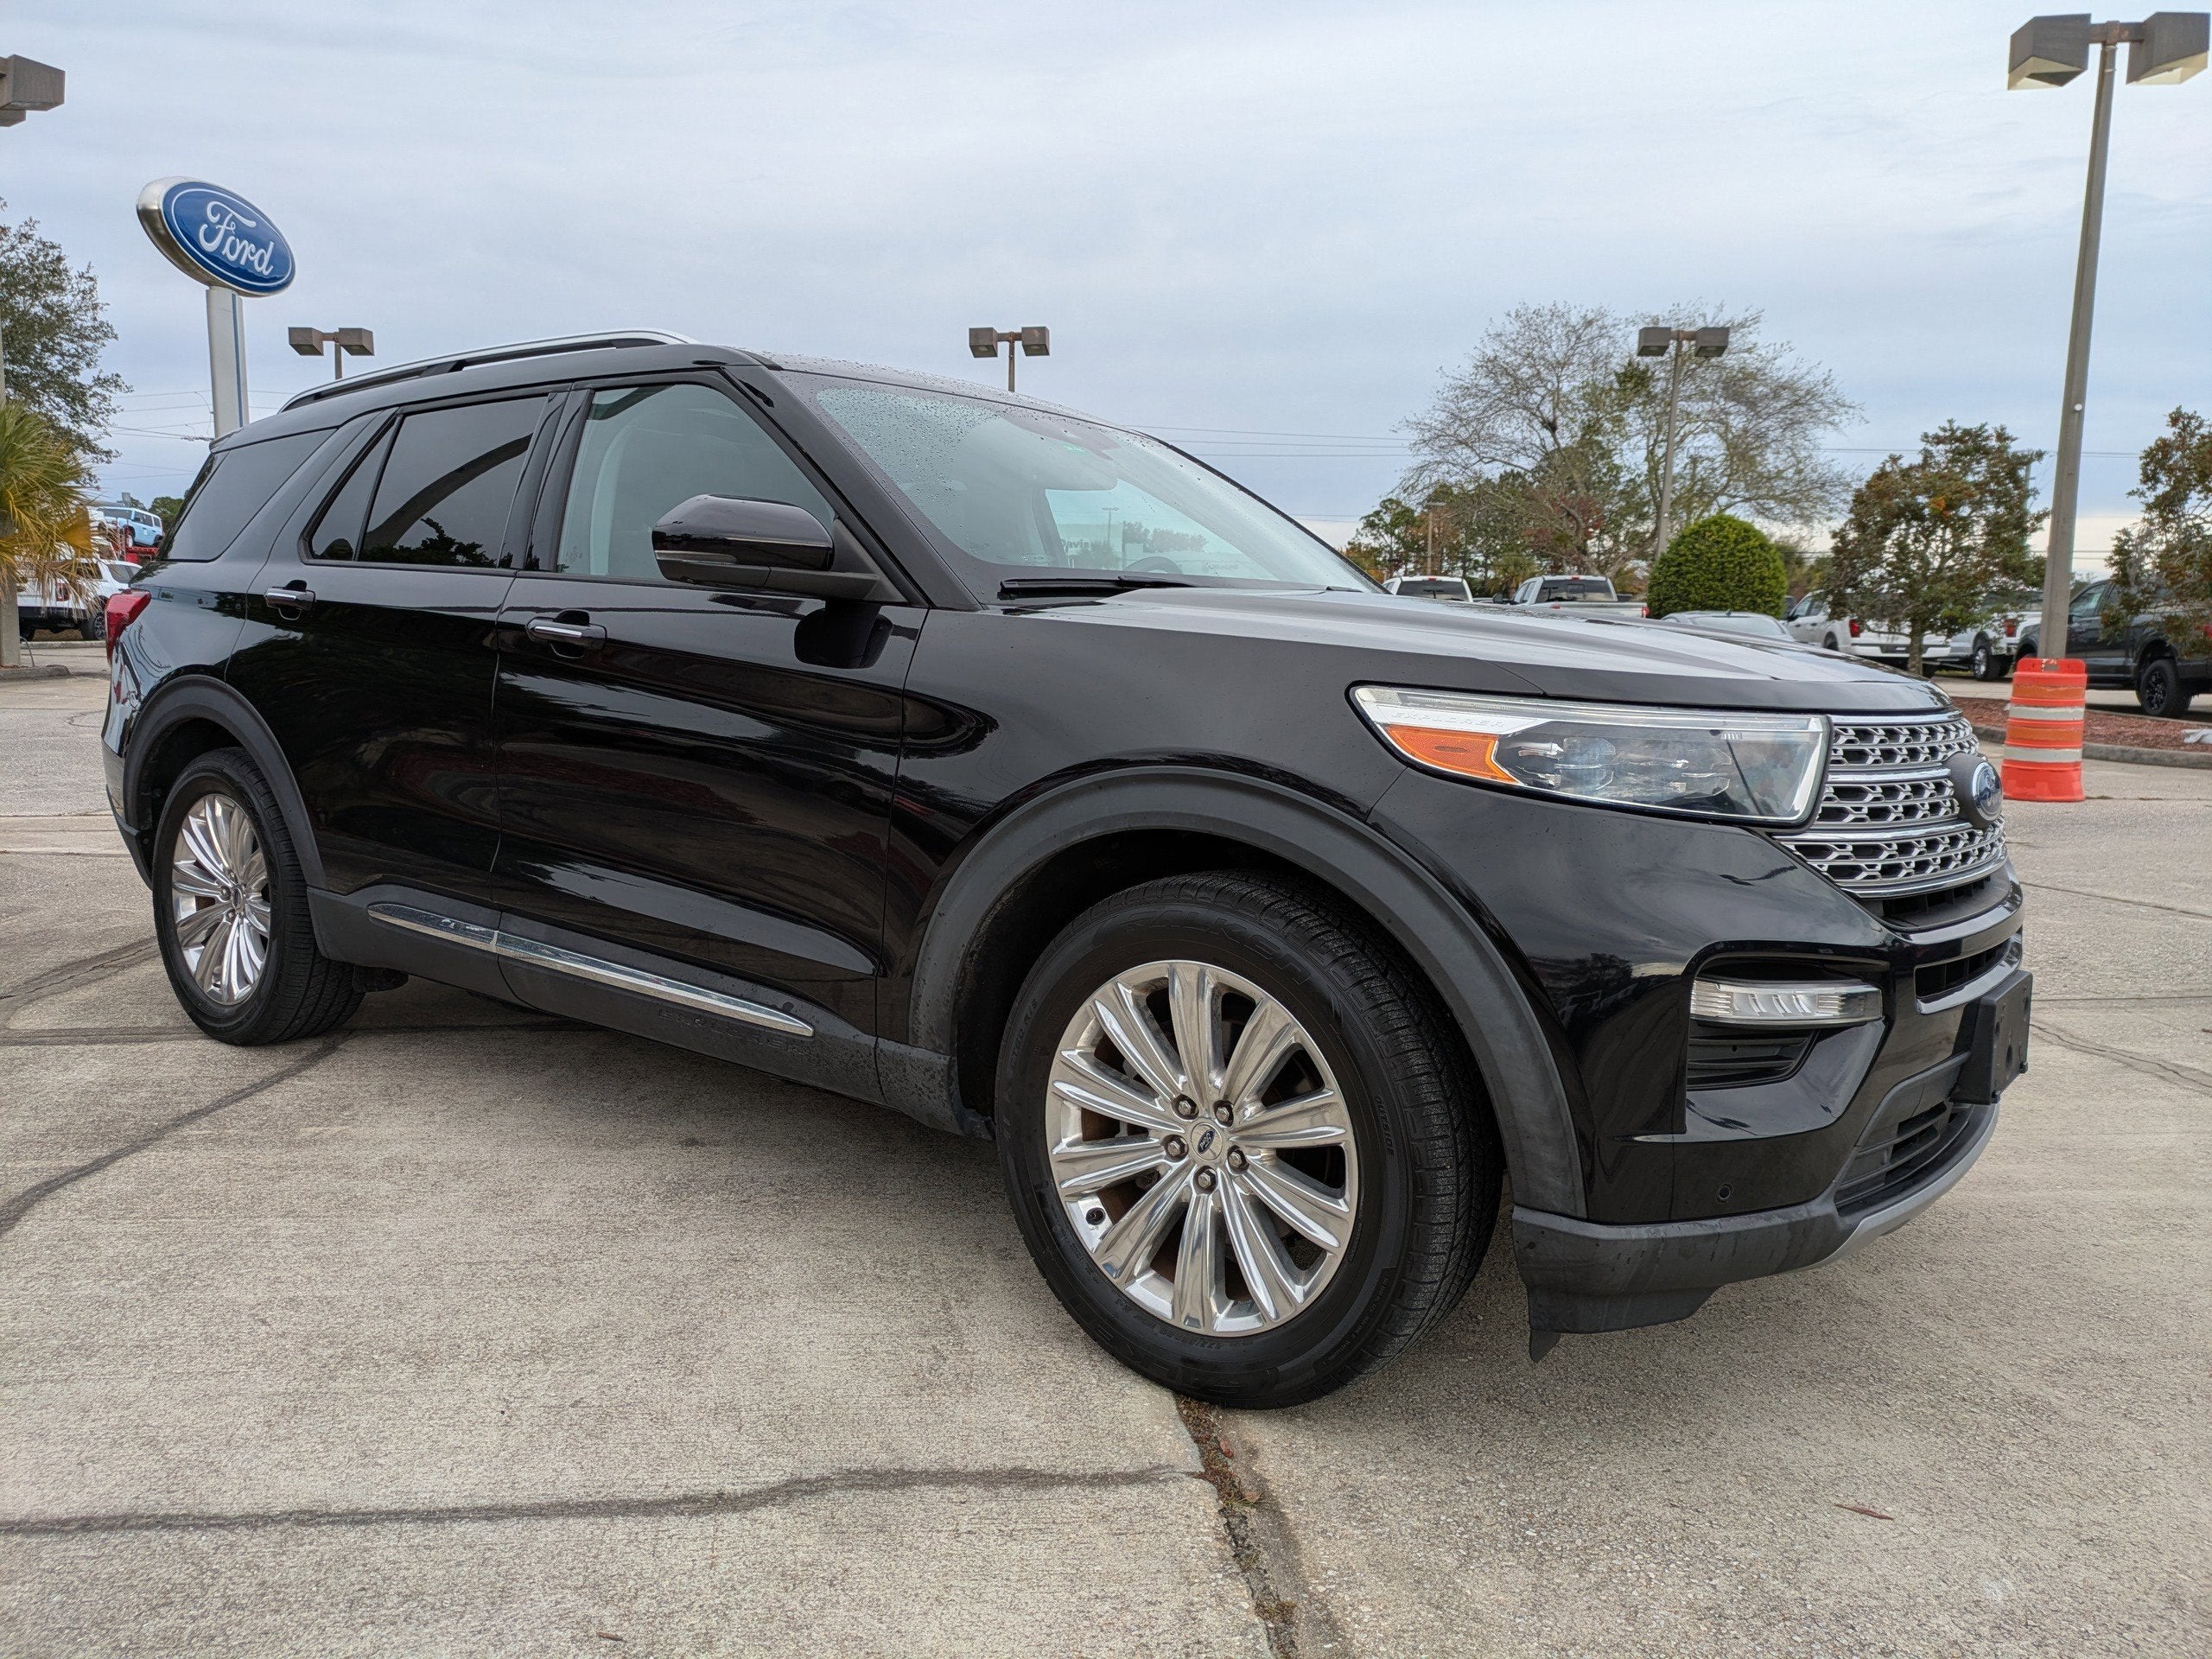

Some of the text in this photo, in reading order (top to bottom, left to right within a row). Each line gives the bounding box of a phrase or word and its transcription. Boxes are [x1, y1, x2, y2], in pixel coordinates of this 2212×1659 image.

[199, 200, 275, 276] Ford
[1391, 711, 1506, 727] EXPLORER
[1374, 1092, 1395, 1156] OUTSIDE
